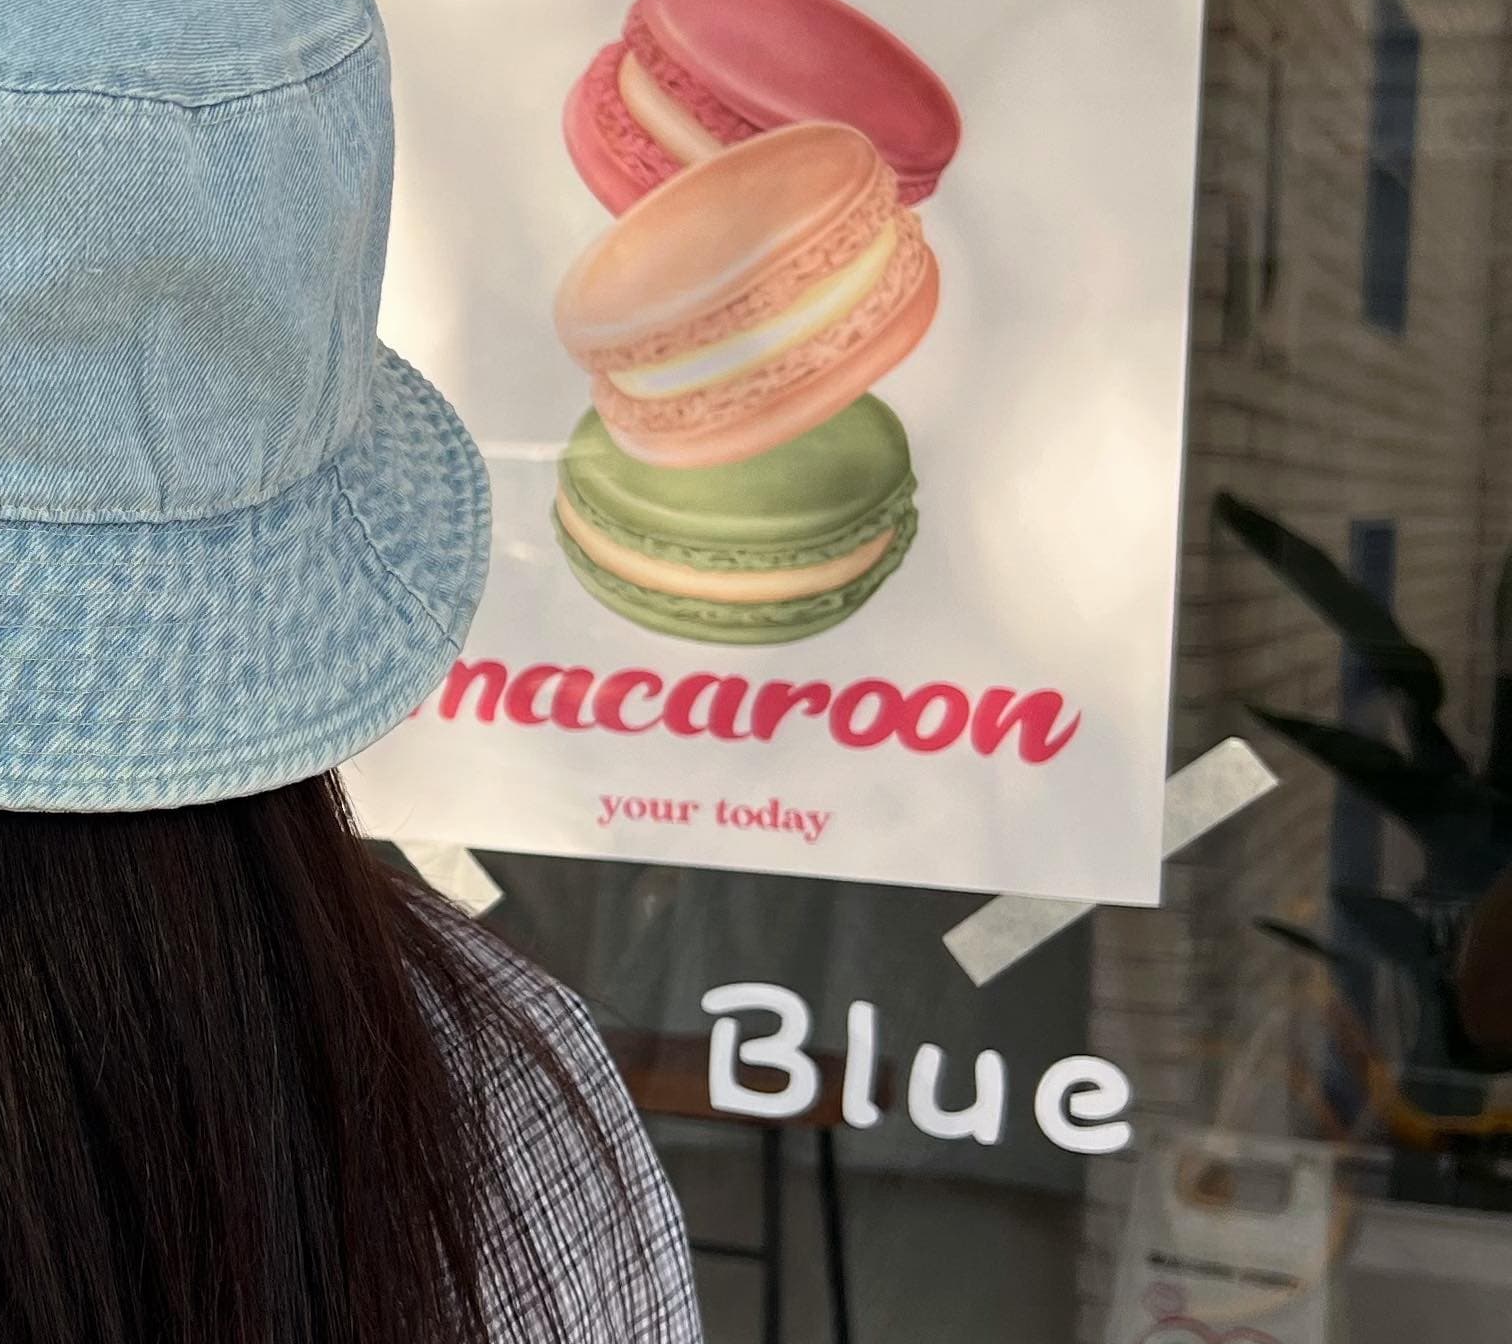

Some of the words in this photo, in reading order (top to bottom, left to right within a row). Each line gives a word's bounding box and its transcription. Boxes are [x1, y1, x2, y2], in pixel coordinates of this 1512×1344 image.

[596, 794, 700, 828] your
[714, 797, 831, 844] today
[700, 982, 1132, 1154] Blue
